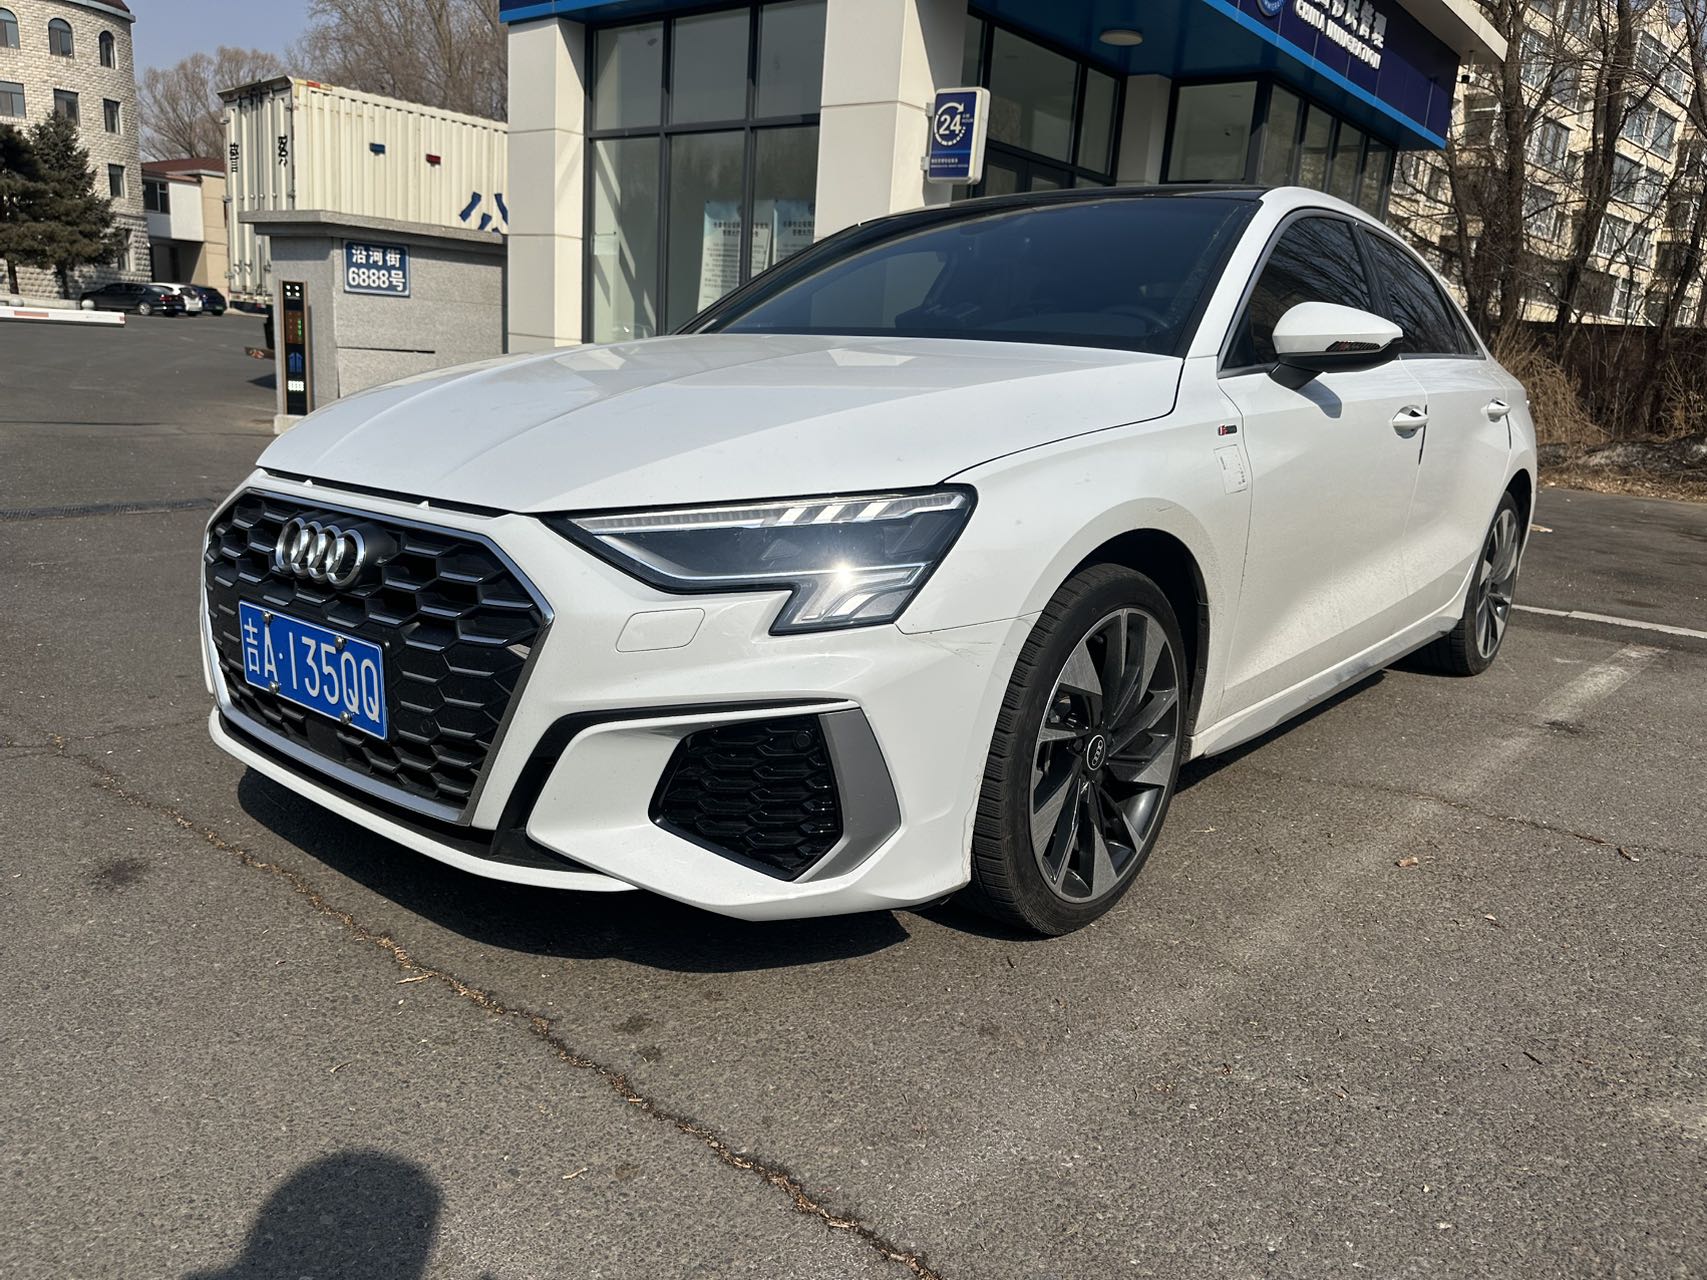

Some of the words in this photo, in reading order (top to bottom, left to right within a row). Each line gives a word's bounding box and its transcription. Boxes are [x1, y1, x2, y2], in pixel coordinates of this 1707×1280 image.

[1296, 0, 1325, 32] CHINA
[1326, 19, 1381, 70] IMMIGRATION
[939, 114, 962, 135] 24
[352, 245, 401, 267] 沿河街
[348, 267, 405, 291] 6888号
